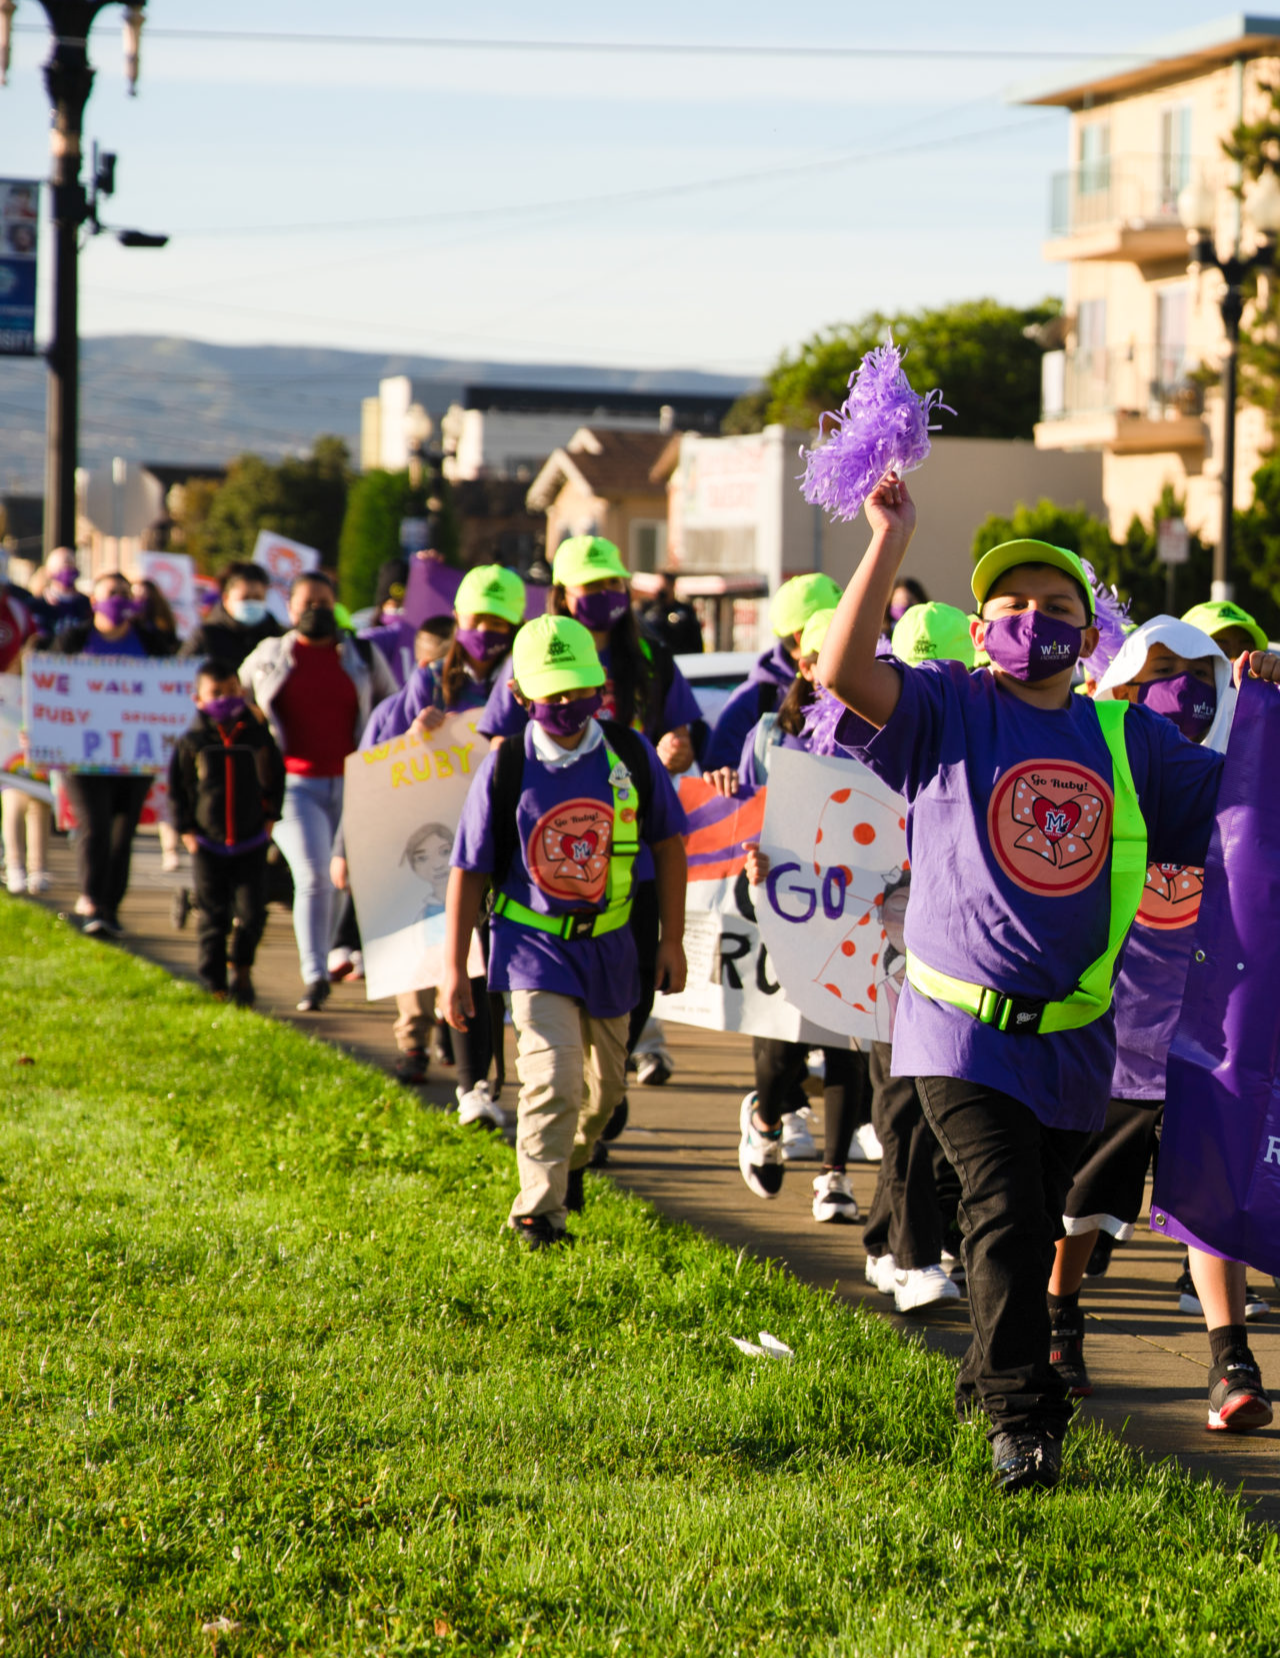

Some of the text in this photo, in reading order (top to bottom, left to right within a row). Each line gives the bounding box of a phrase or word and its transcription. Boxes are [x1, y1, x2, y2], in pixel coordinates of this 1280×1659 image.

[1040, 640, 1070, 655] WLK
[32, 672, 70, 697] WE
[33, 703, 90, 726] RUBY
[82, 729, 155, 760] PTA
[390, 743, 475, 790] RUBY
[1031, 774, 1088, 792] Go Ruby!
[1045, 811, 1067, 833] M
[766, 862, 846, 924] GO
